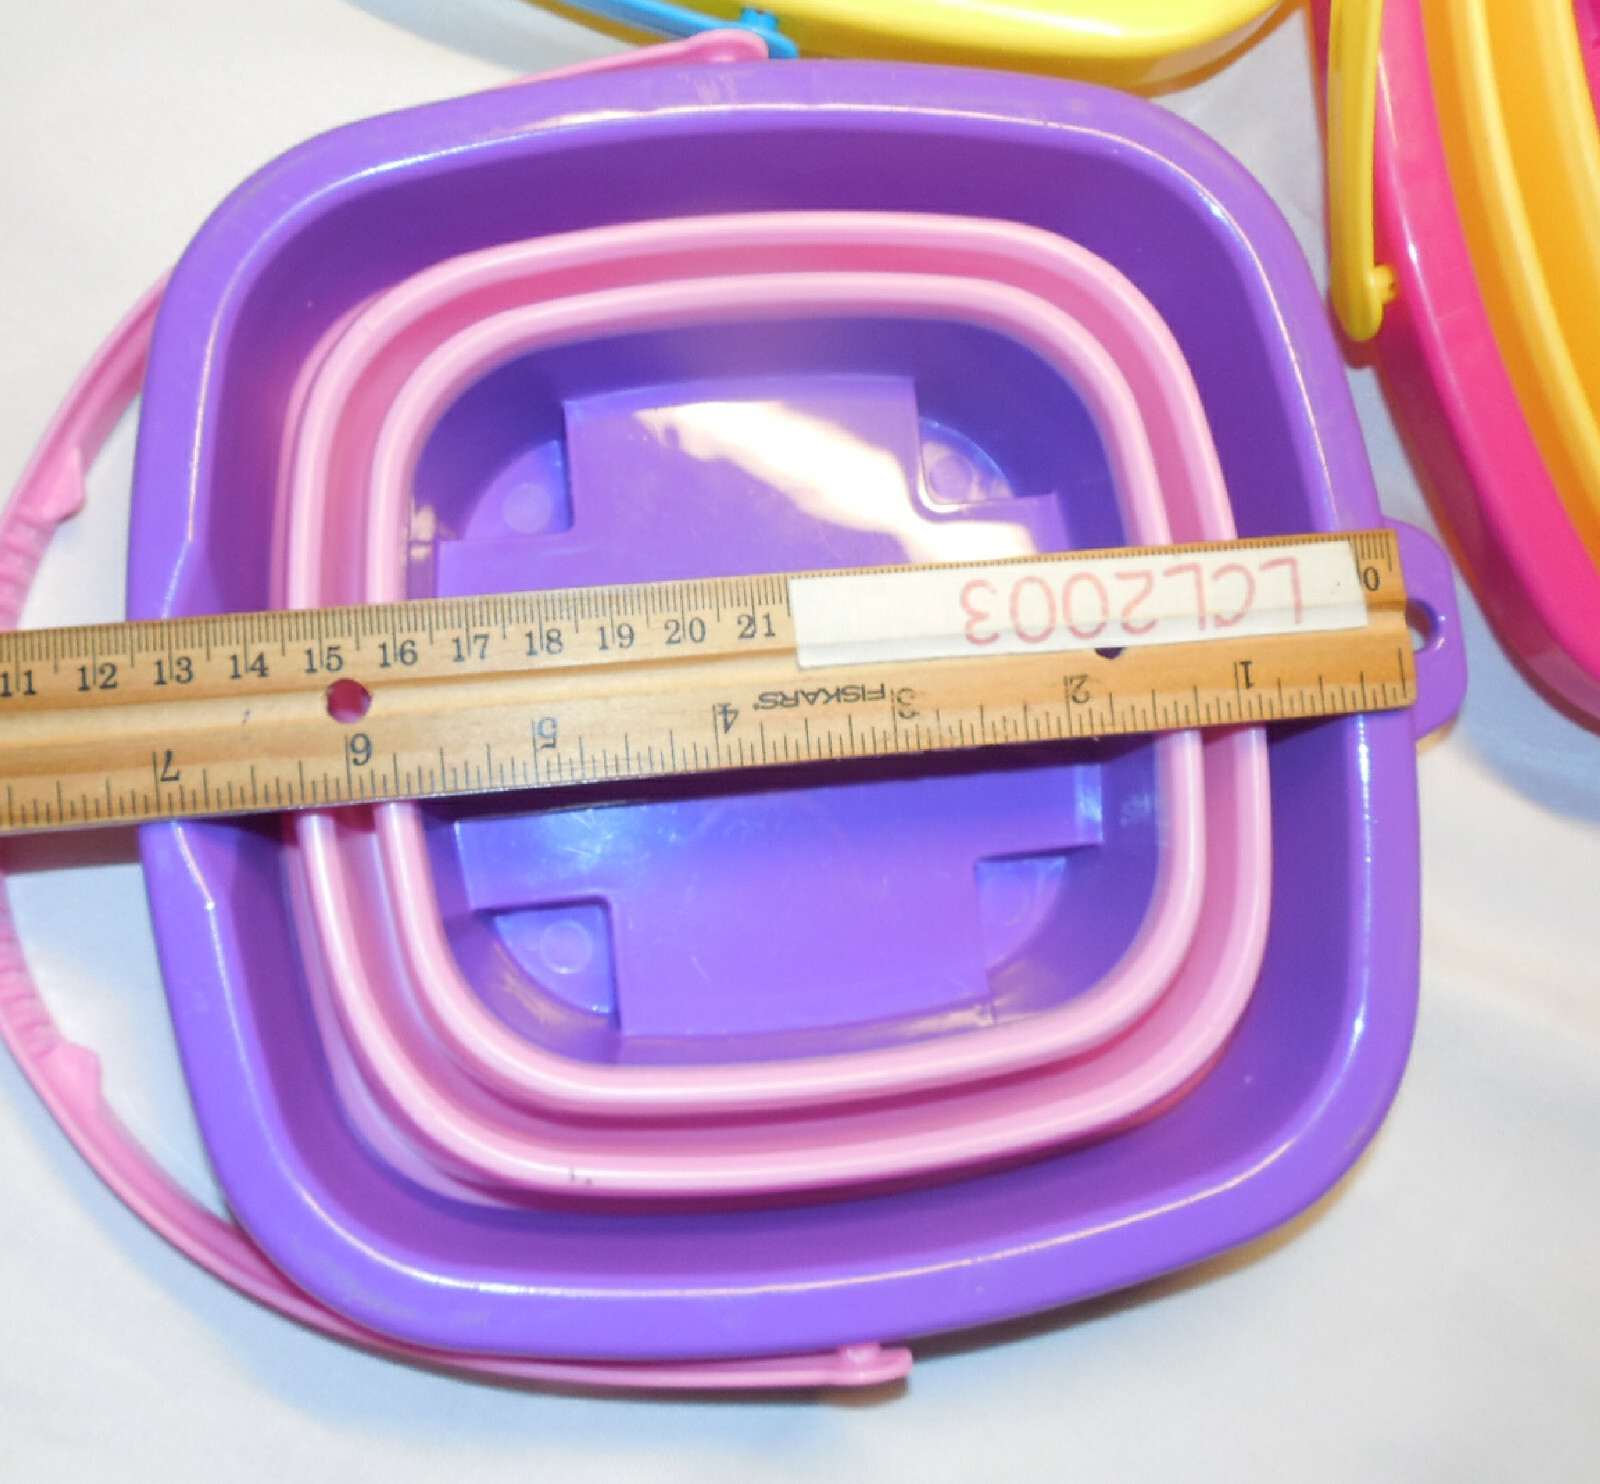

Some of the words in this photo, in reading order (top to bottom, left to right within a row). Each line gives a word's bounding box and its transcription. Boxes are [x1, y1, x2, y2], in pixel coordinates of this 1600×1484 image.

[960, 556, 1304, 646] LCL2003
[0, 668, 37, 697] 11
[76, 661, 118, 692] 12
[153, 656, 194, 686] 13
[229, 652, 269, 680] 14
[304, 645, 345, 674] 15
[378, 640, 418, 669] 16
[452, 633, 490, 663] 17
[525, 628, 564, 657] 18
[598, 622, 636, 651] 19
[664, 617, 707, 646] 20
[737, 612, 776, 641] 21
[1068, 674, 1092, 704] 2
[1238, 660, 1254, 690] 1
[719, 703, 740, 736] 4
[897, 686, 921, 720] 3
[350, 732, 373, 767] 6
[537, 717, 560, 750] 5
[160, 749, 181, 782] 7
